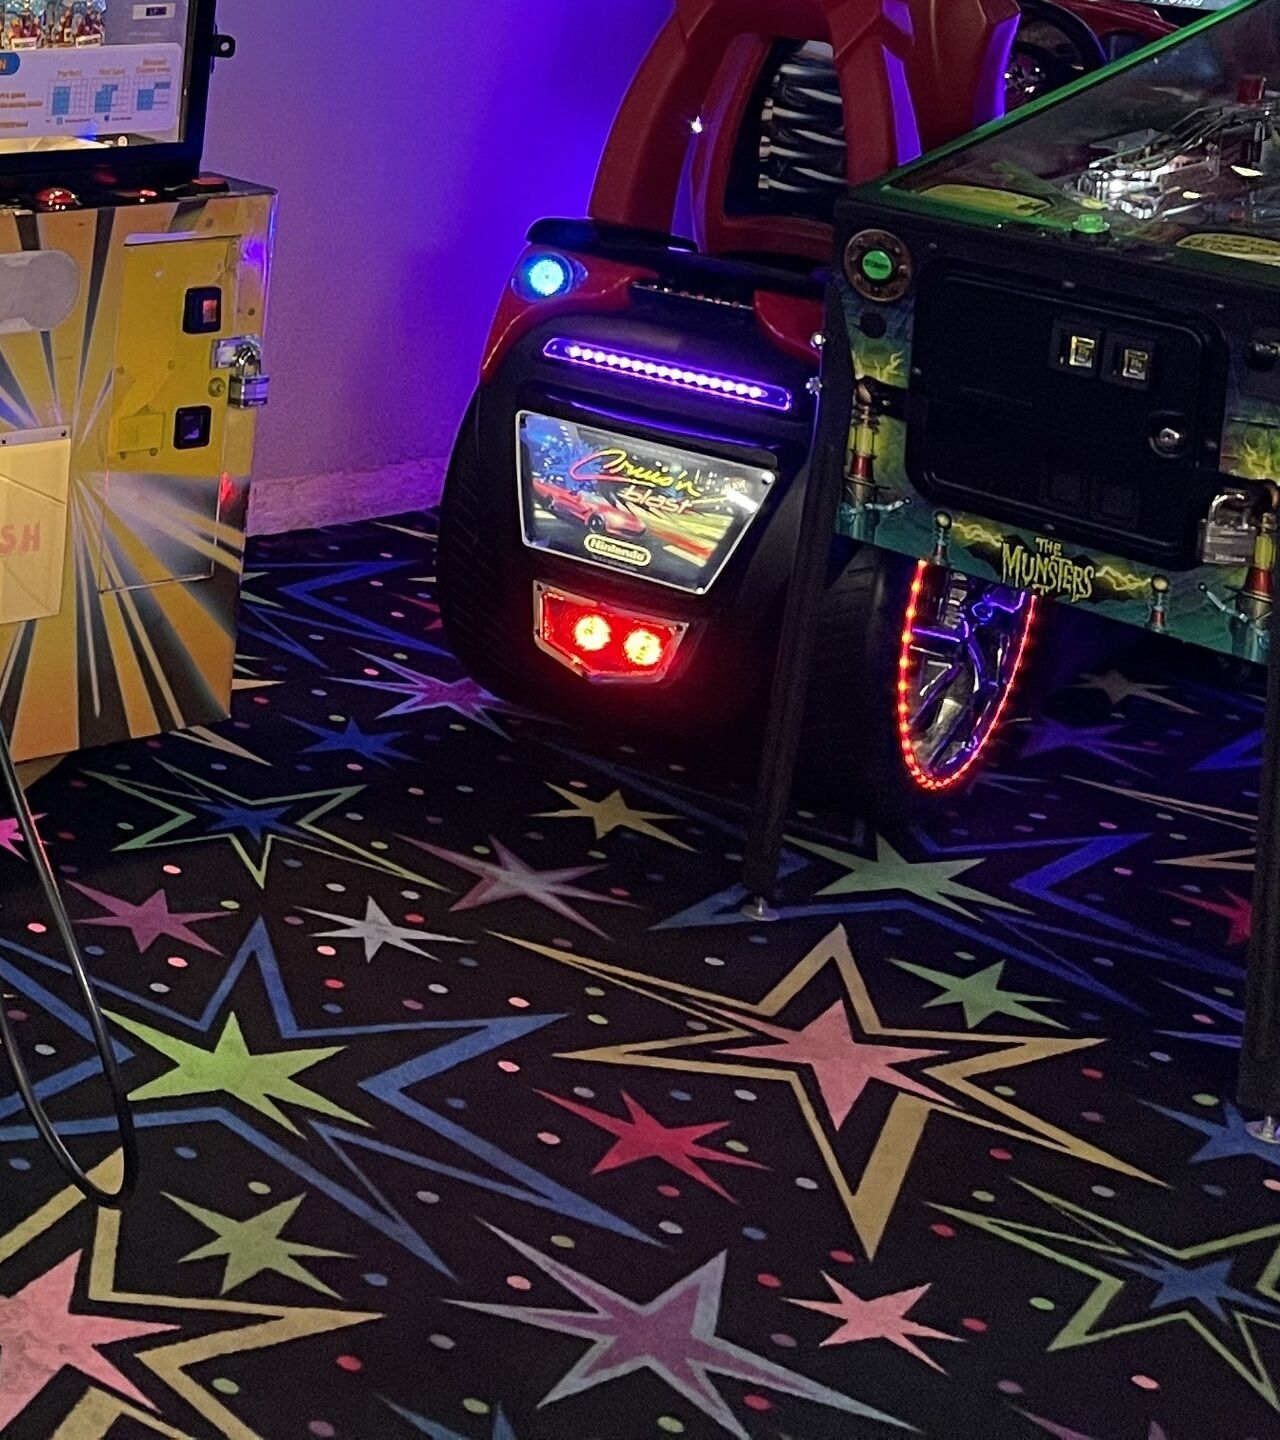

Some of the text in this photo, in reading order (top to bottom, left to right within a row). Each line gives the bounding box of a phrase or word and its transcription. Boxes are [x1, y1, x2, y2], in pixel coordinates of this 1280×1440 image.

[571, 448, 701, 498] Cruis'n
[617, 484, 693, 514] blast
[590, 537, 646, 561] Nintendo
[1034, 536, 1062, 560] THE
[1000, 541, 1096, 603] MUNSTERS
